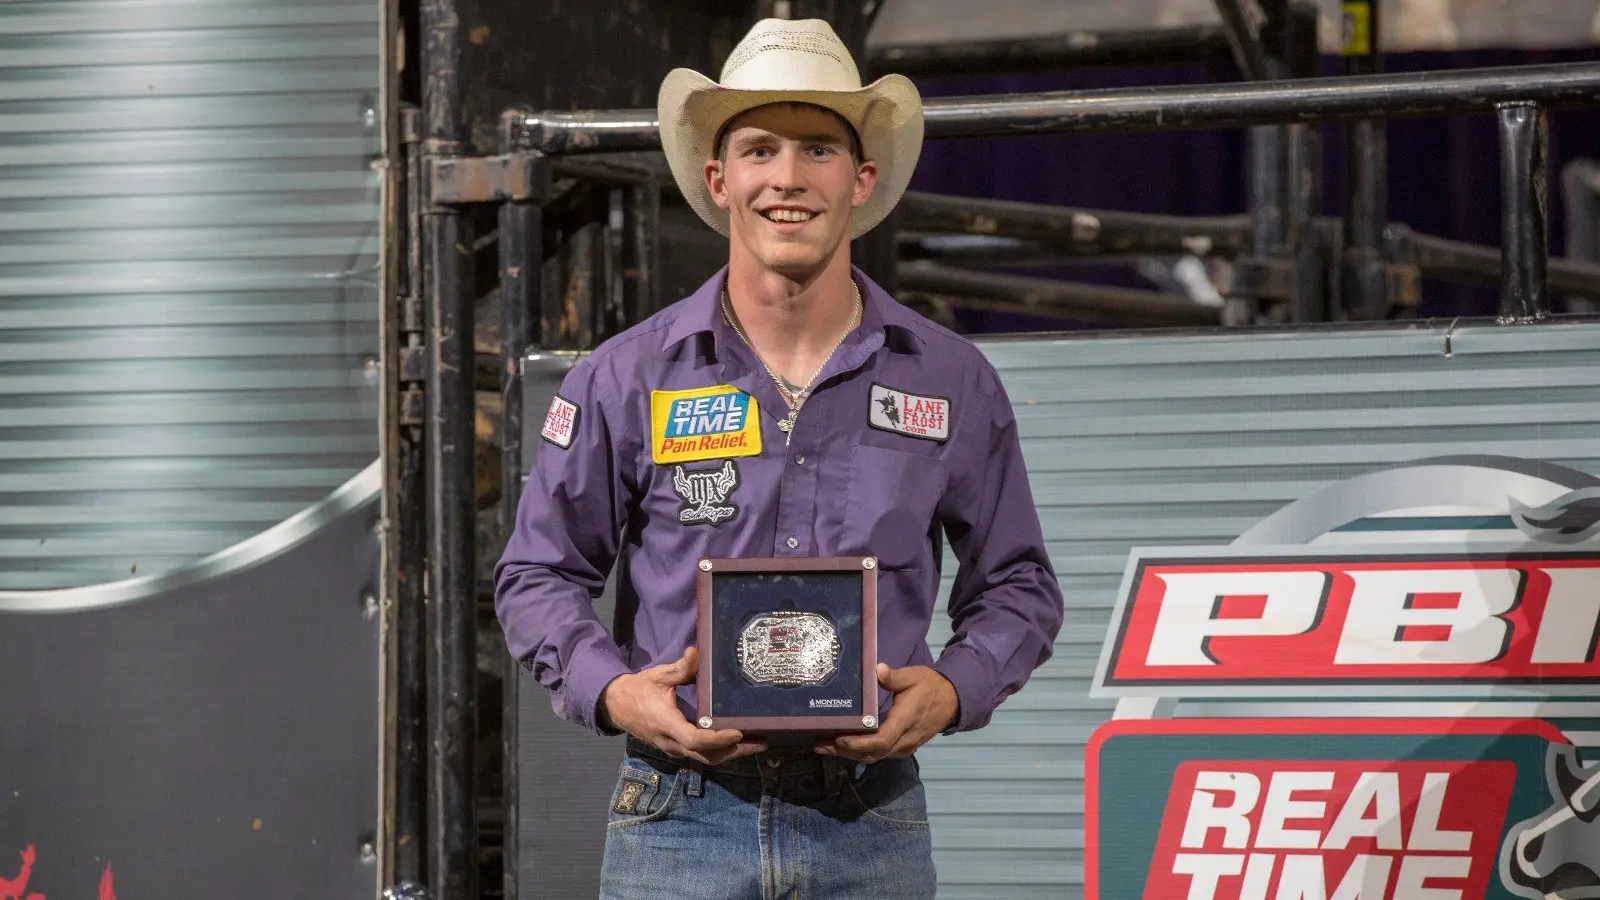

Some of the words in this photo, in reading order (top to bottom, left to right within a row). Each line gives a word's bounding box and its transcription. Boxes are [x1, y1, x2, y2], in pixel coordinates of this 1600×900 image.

[675, 395, 743, 417] REAL
[903, 395, 945, 415] LANE
[673, 411, 743, 435] TIME
[902, 411, 945, 430] FROST
[902, 425, 927, 435] .com
[660, 437, 697, 455] Pain
[1180, 770, 1473, 851] REAL
[1172, 852, 1473, 900] TIME
